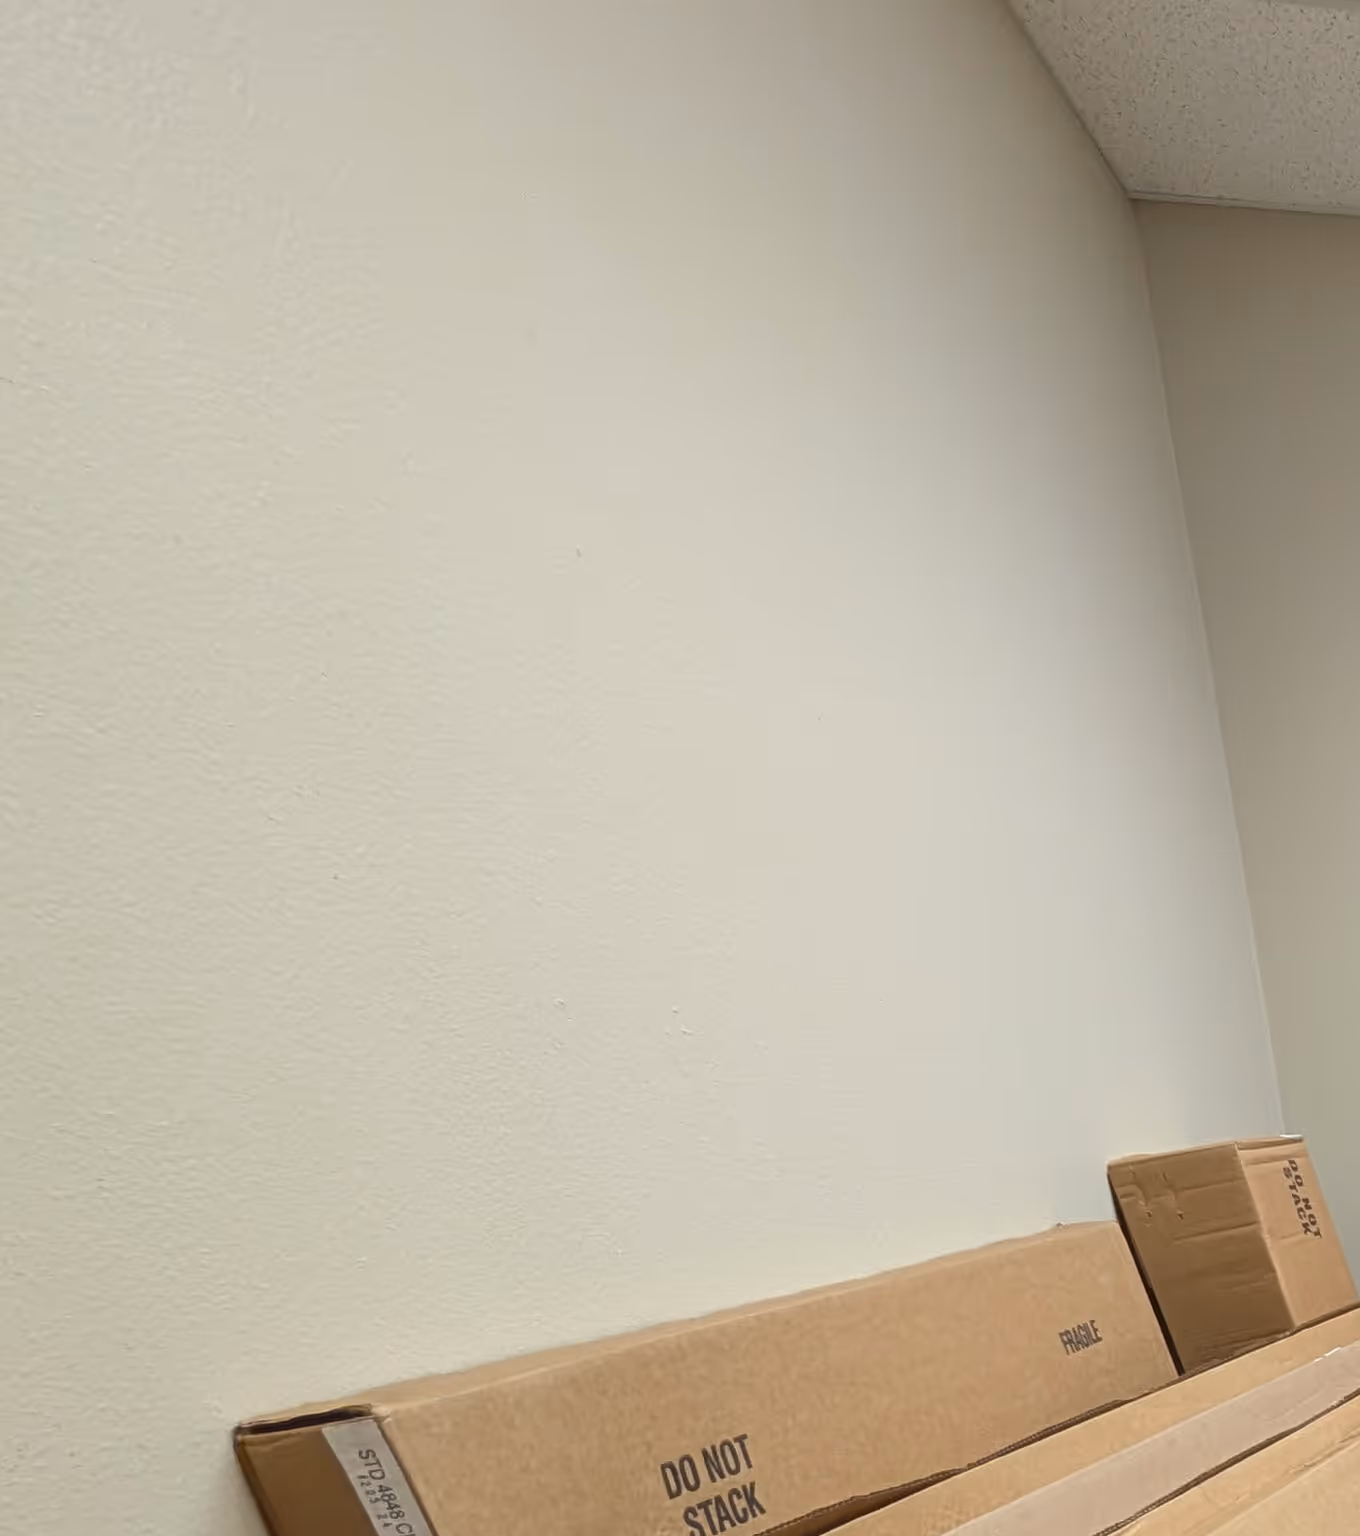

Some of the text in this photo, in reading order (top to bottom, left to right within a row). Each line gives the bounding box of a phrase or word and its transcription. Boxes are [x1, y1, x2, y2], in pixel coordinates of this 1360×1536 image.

[1283, 1168, 1313, 1234] STACK
[1288, 1160, 1322, 1239] DO NOT
[1059, 1319, 1103, 1355] FRAGILE
[359, 1449, 385, 1480] STD
[378, 1485, 405, 1519] 4848
[660, 1434, 753, 1500] DO NOT
